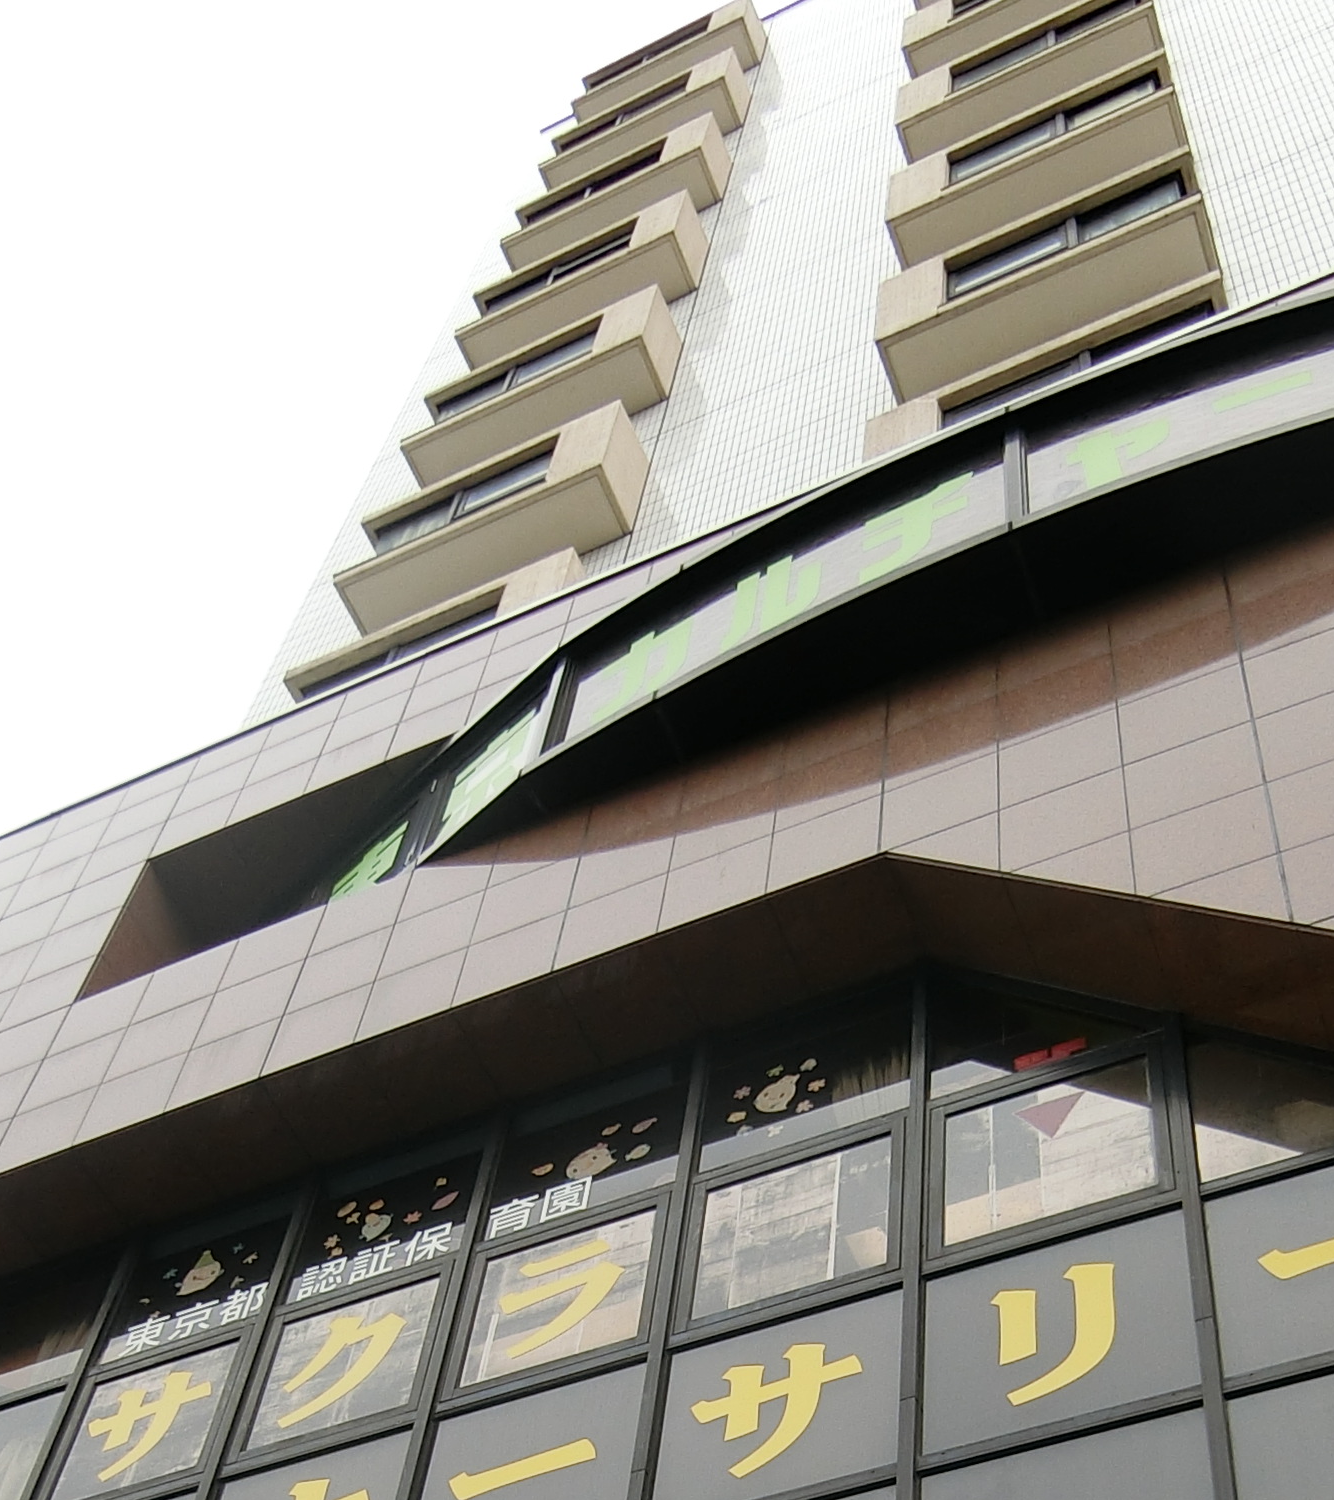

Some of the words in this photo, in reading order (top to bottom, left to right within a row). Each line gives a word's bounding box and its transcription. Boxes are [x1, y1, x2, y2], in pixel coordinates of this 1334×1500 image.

[88, 1240, 625, 1482] サクラ
[119, 1176, 592, 1358] 東京都認証保育園
